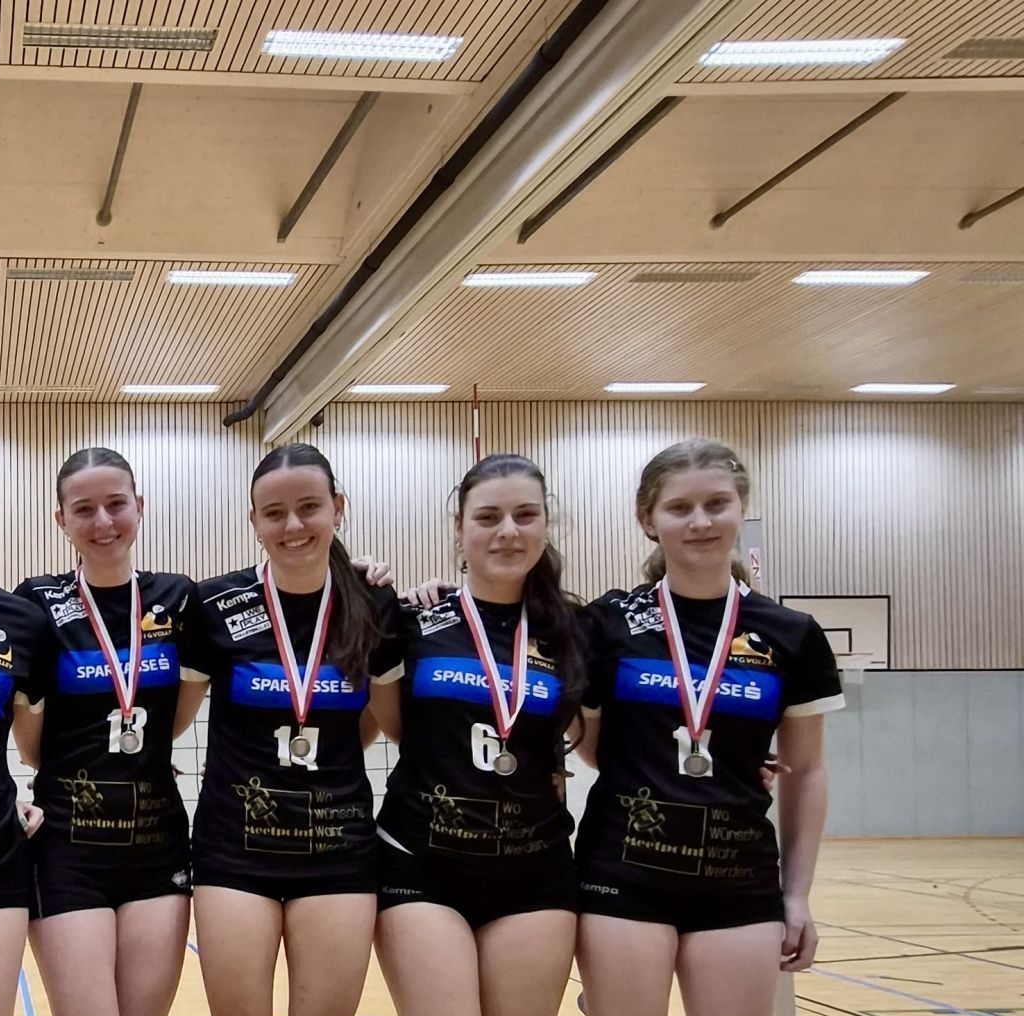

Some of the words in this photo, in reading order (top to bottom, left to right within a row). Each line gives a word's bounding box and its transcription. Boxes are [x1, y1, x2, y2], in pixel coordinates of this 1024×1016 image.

[242, 614, 268, 629] PLAY
[246, 606, 264, 618] WE
[77, 659, 158, 679] SPARASE
[251, 677, 339, 693] SPARSSE
[432, 669, 531, 696] SPARKSE
[107, 706, 148, 754] 13
[471, 723, 502, 772] 6
